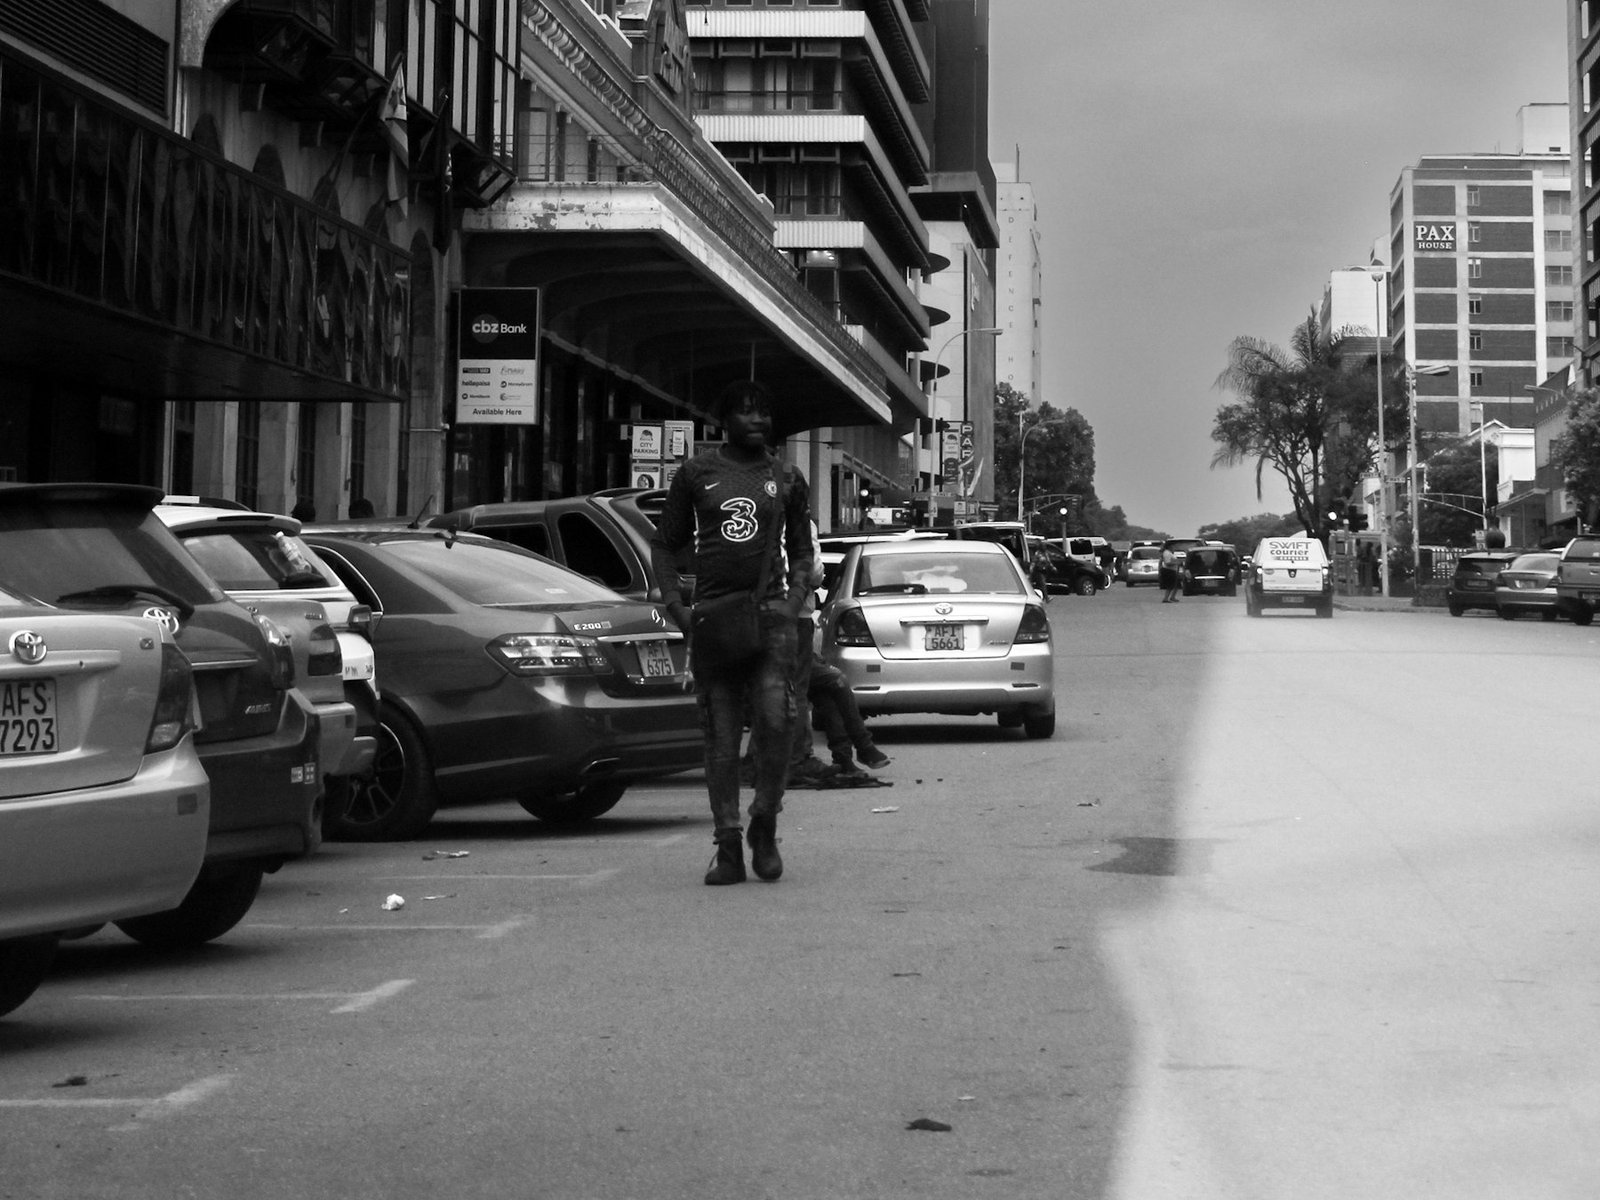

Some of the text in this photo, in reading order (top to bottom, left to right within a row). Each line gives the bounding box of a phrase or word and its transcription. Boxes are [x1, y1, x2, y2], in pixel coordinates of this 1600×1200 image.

[1415, 225, 1455, 241] PAX
[472, 319, 527, 334] cbz Bank
[472, 408, 522, 416] Available Here
[720, 497, 759, 543] 3
[1269, 541, 1312, 550] SWIFT
[573, 622, 602, 631] E200
[934, 626, 956, 637] AFI
[931, 638, 960, 650] 5661
[647, 658, 672, 675] 6375
[2, 682, 47, 716] AFS
[0, 717, 55, 753] 7293
